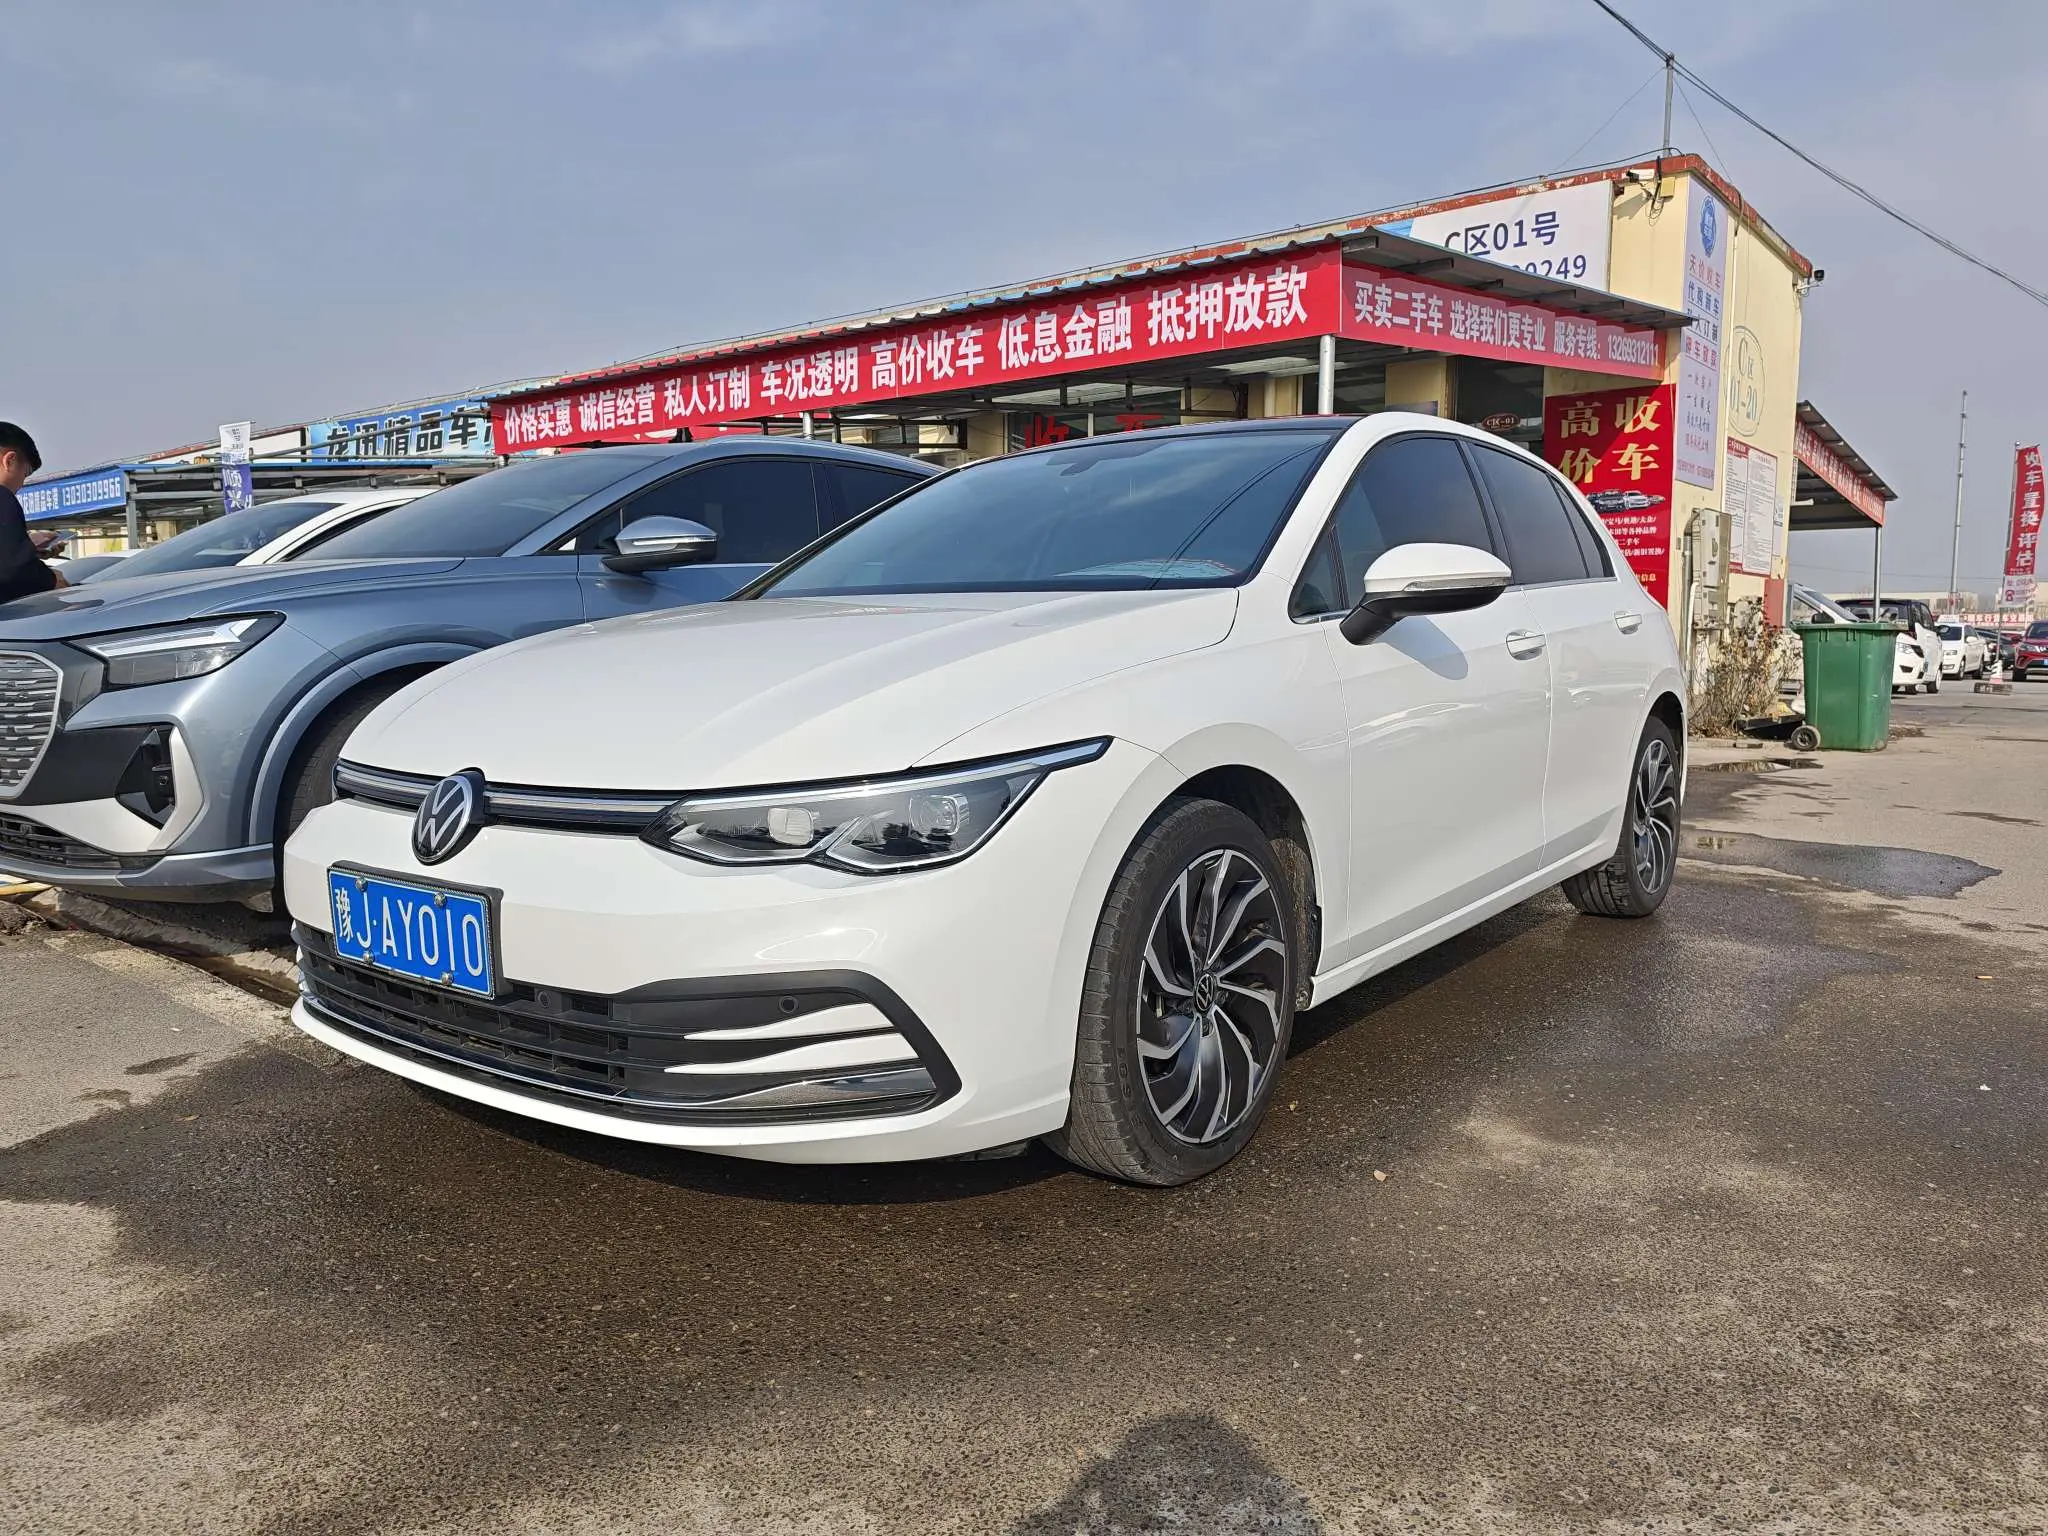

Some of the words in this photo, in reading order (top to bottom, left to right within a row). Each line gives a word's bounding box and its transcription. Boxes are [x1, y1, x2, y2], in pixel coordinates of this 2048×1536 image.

[1445, 211, 1560, 256] C区01号
[1512, 254, 1587, 280] 0249
[1354, 281, 1443, 336] 买卖二手车
[1450, 300, 1546, 351] 选择我们更专业
[504, 399, 573, 444] 价格实惠
[579, 384, 656, 432] 诚信经营
[663, 365, 750, 420] 私人订制
[760, 347, 859, 406] 车况透明
[871, 325, 985, 390] 高价收车
[998, 296, 1133, 371] 低息金融
[1148, 265, 1308, 346] 抵押放款
